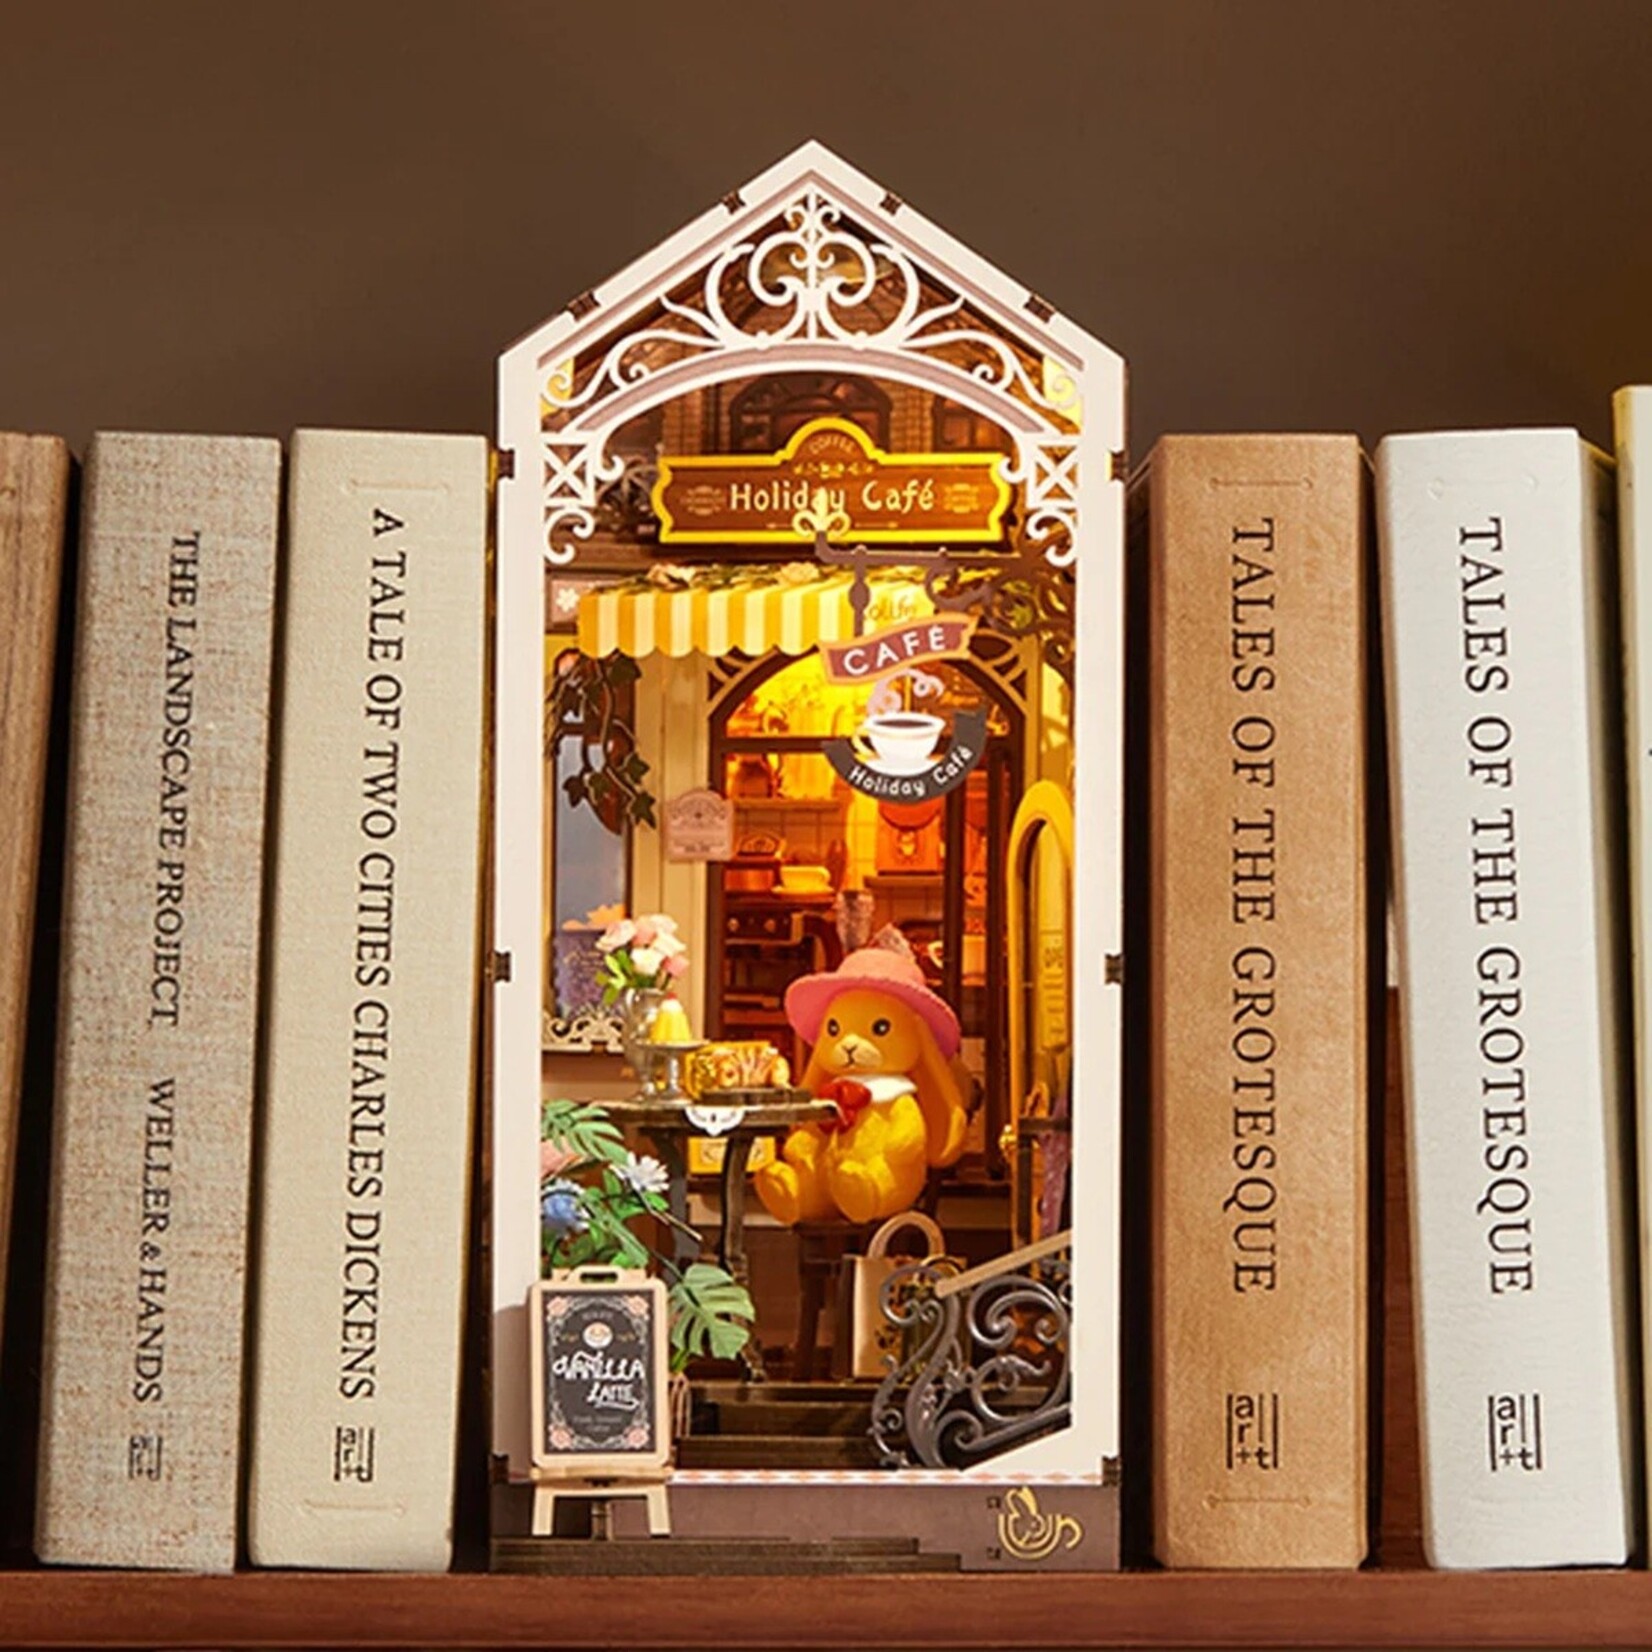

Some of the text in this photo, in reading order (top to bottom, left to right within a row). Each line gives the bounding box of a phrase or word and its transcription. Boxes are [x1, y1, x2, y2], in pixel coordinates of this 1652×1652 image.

[861, 478, 934, 514] Café
[167, 531, 200, 607] THE
[842, 625, 946, 676] CAFÉ
[158, 616, 197, 850] LANDSCAPE
[849, 744, 974, 797] Holiday Café
[339, 508, 407, 1399] A TALE OF TWO CITIES CHARLES DICKENS
[1222, 517, 1278, 1293] TALES OF THE GROTESQUE
[1459, 517, 1533, 1294] TALES OF THE GROTESQUE
[140, 1077, 175, 1236] WELLER
[139, 1241, 161, 1261] &
[132, 1268, 167, 1403] HANDS
